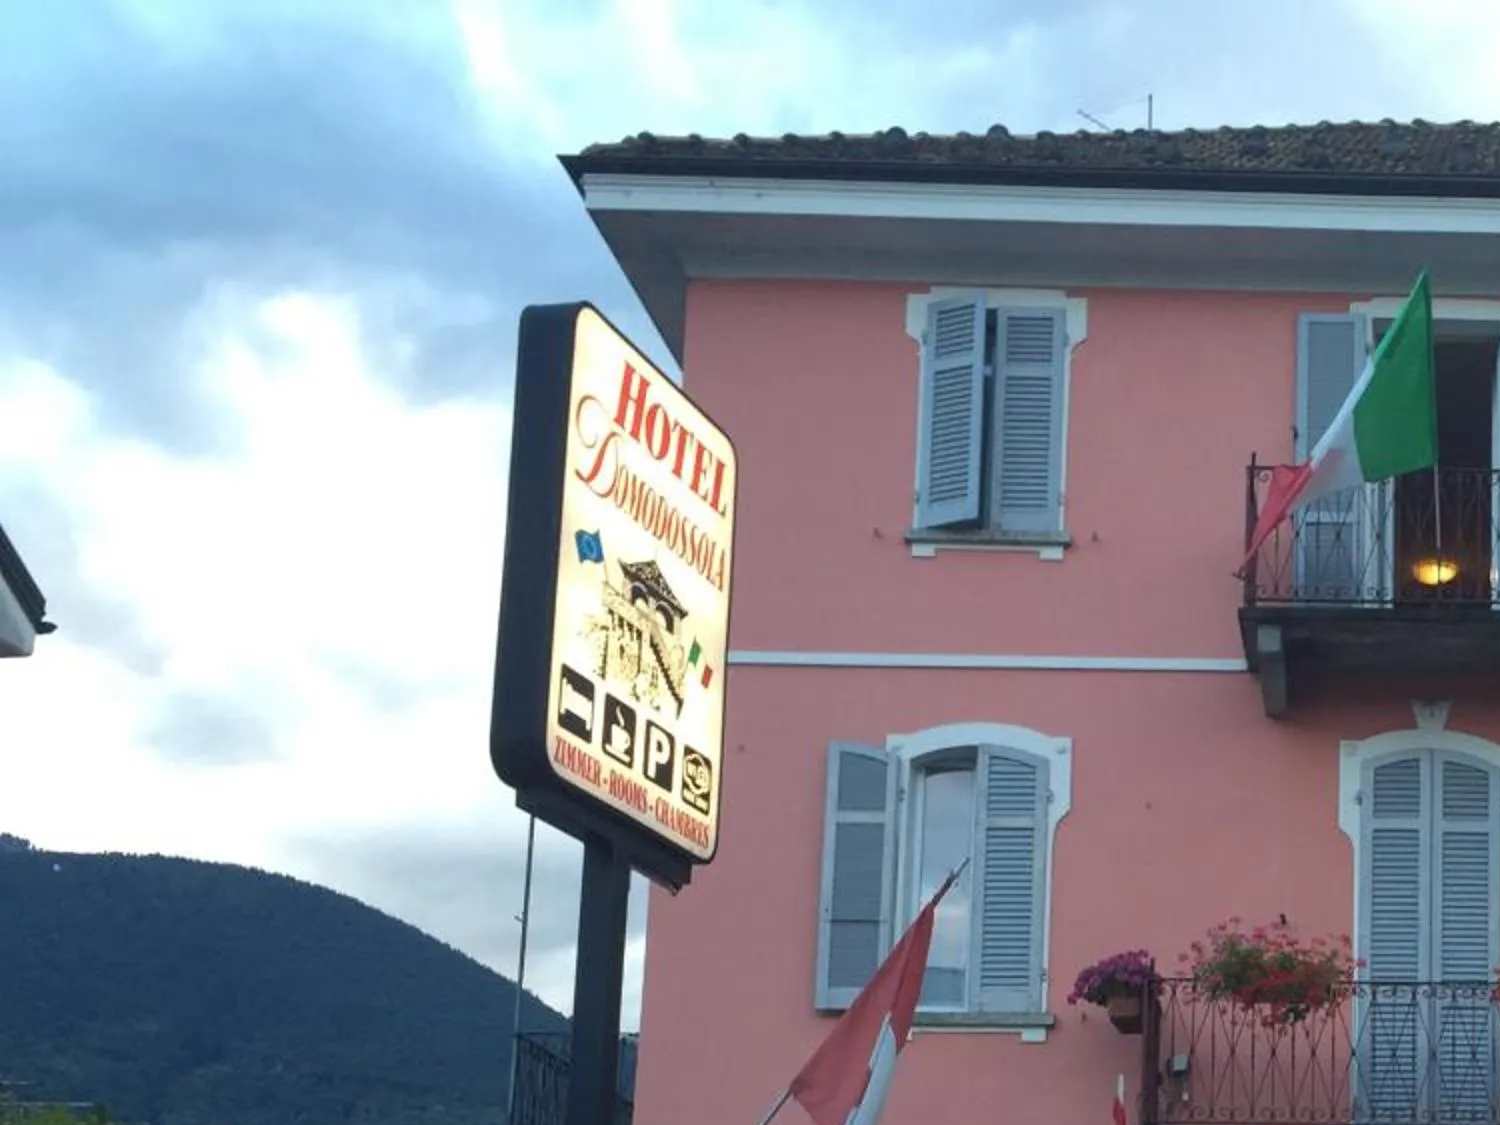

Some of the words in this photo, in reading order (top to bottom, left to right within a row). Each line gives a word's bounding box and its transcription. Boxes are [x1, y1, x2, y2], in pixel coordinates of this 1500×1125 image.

[574, 394, 726, 592] DOMODOSSOLA
[613, 359, 728, 519] HOTEL
[554, 735, 602, 788] ZIMMER
[608, 769, 649, 814] ROOMS
[655, 797, 710, 849] CHAMBRES
[647, 725, 670, 779] P
